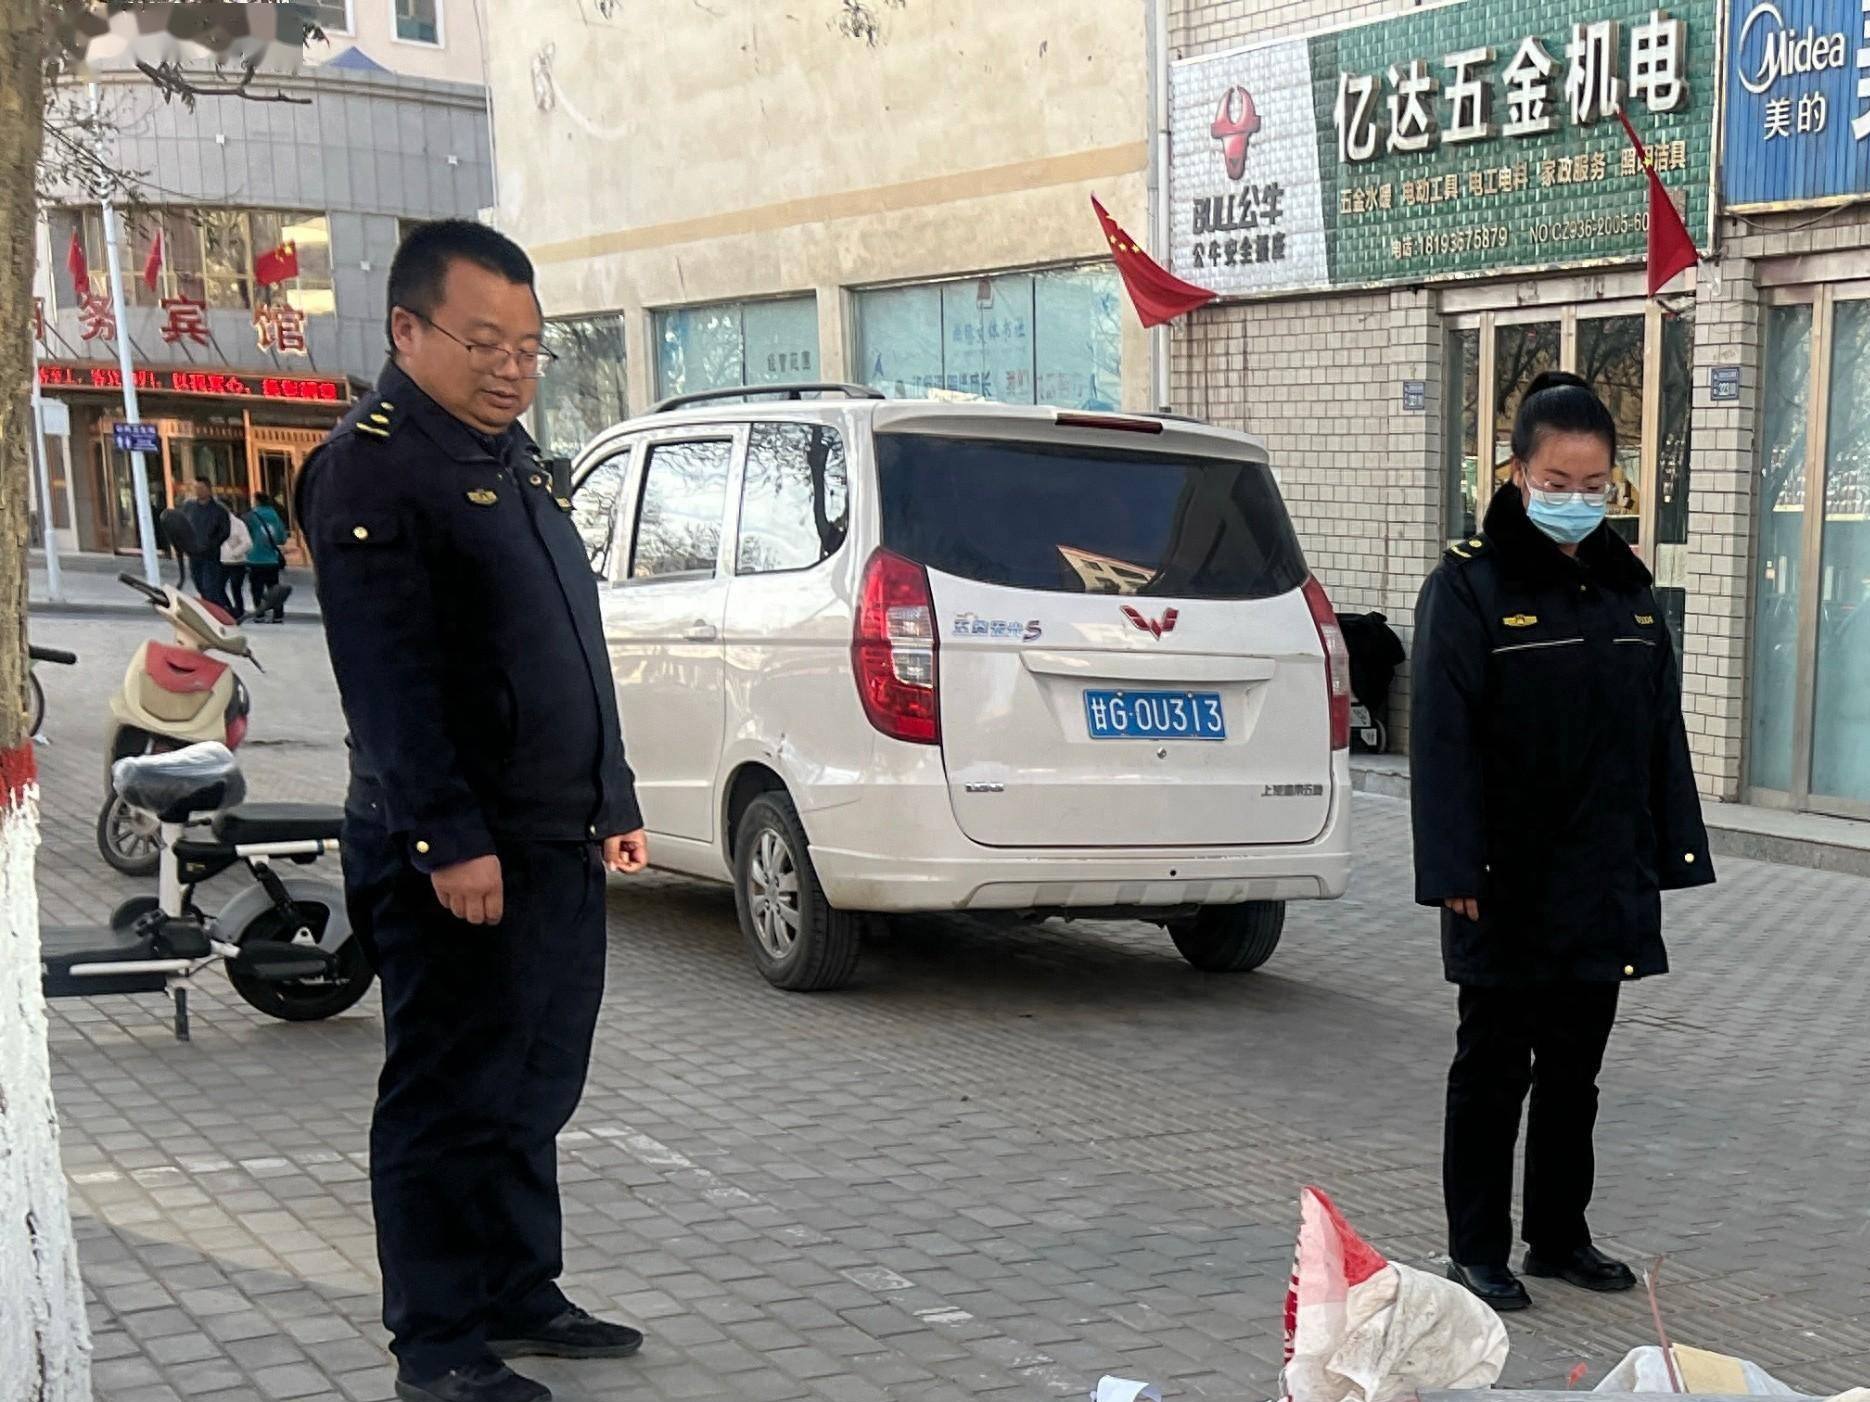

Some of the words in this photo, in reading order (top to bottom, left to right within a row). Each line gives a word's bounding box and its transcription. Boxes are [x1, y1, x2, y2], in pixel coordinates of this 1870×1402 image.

[1334, 8, 1688, 163] 亿达五金机电
[1748, 20, 1845, 88] Midea
[1763, 91, 1827, 140] 美的
[1339, 182, 1393, 215] 五金水暖
[1402, 174, 1458, 205] 电动工具
[1539, 151, 1607, 188] 家政服务
